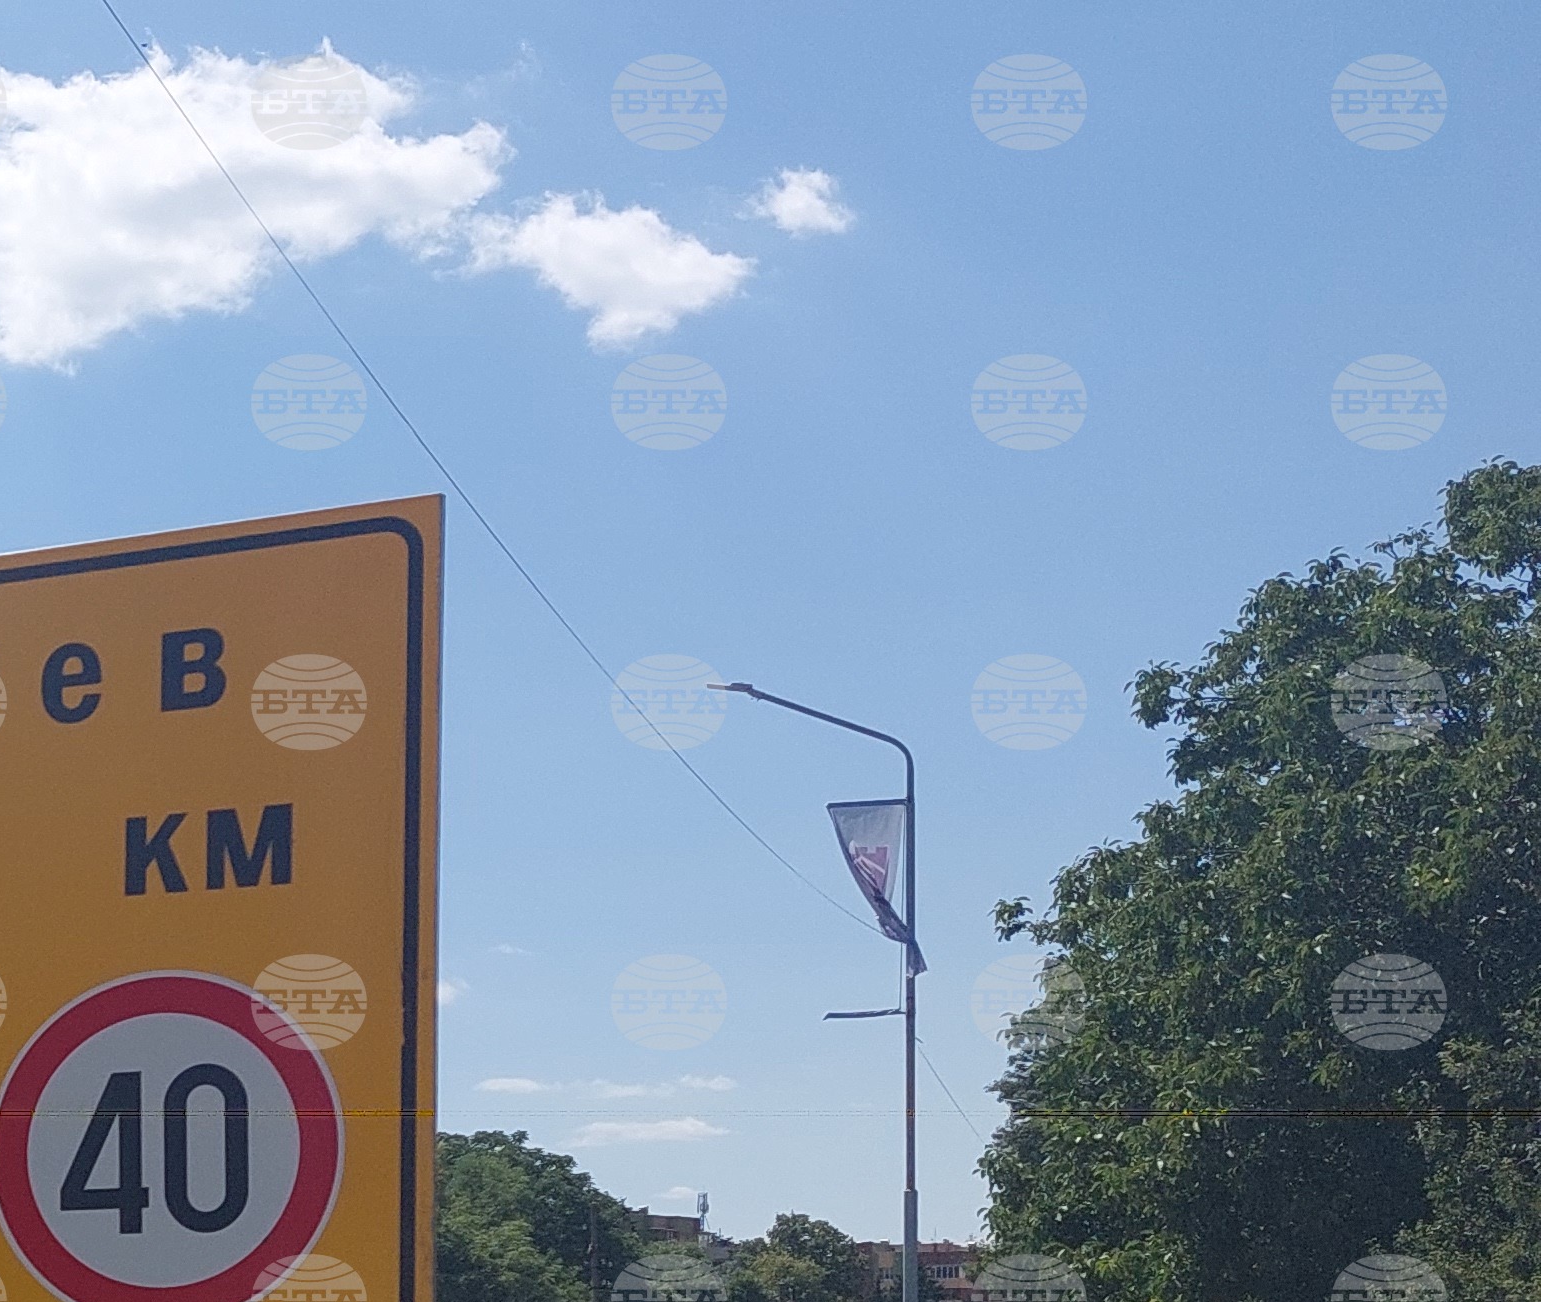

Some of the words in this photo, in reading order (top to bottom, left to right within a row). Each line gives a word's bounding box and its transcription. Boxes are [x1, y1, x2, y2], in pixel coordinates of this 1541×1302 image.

[40, 642, 102, 724] е
[123, 803, 294, 896] км
[60, 1063, 249, 1234] 40
